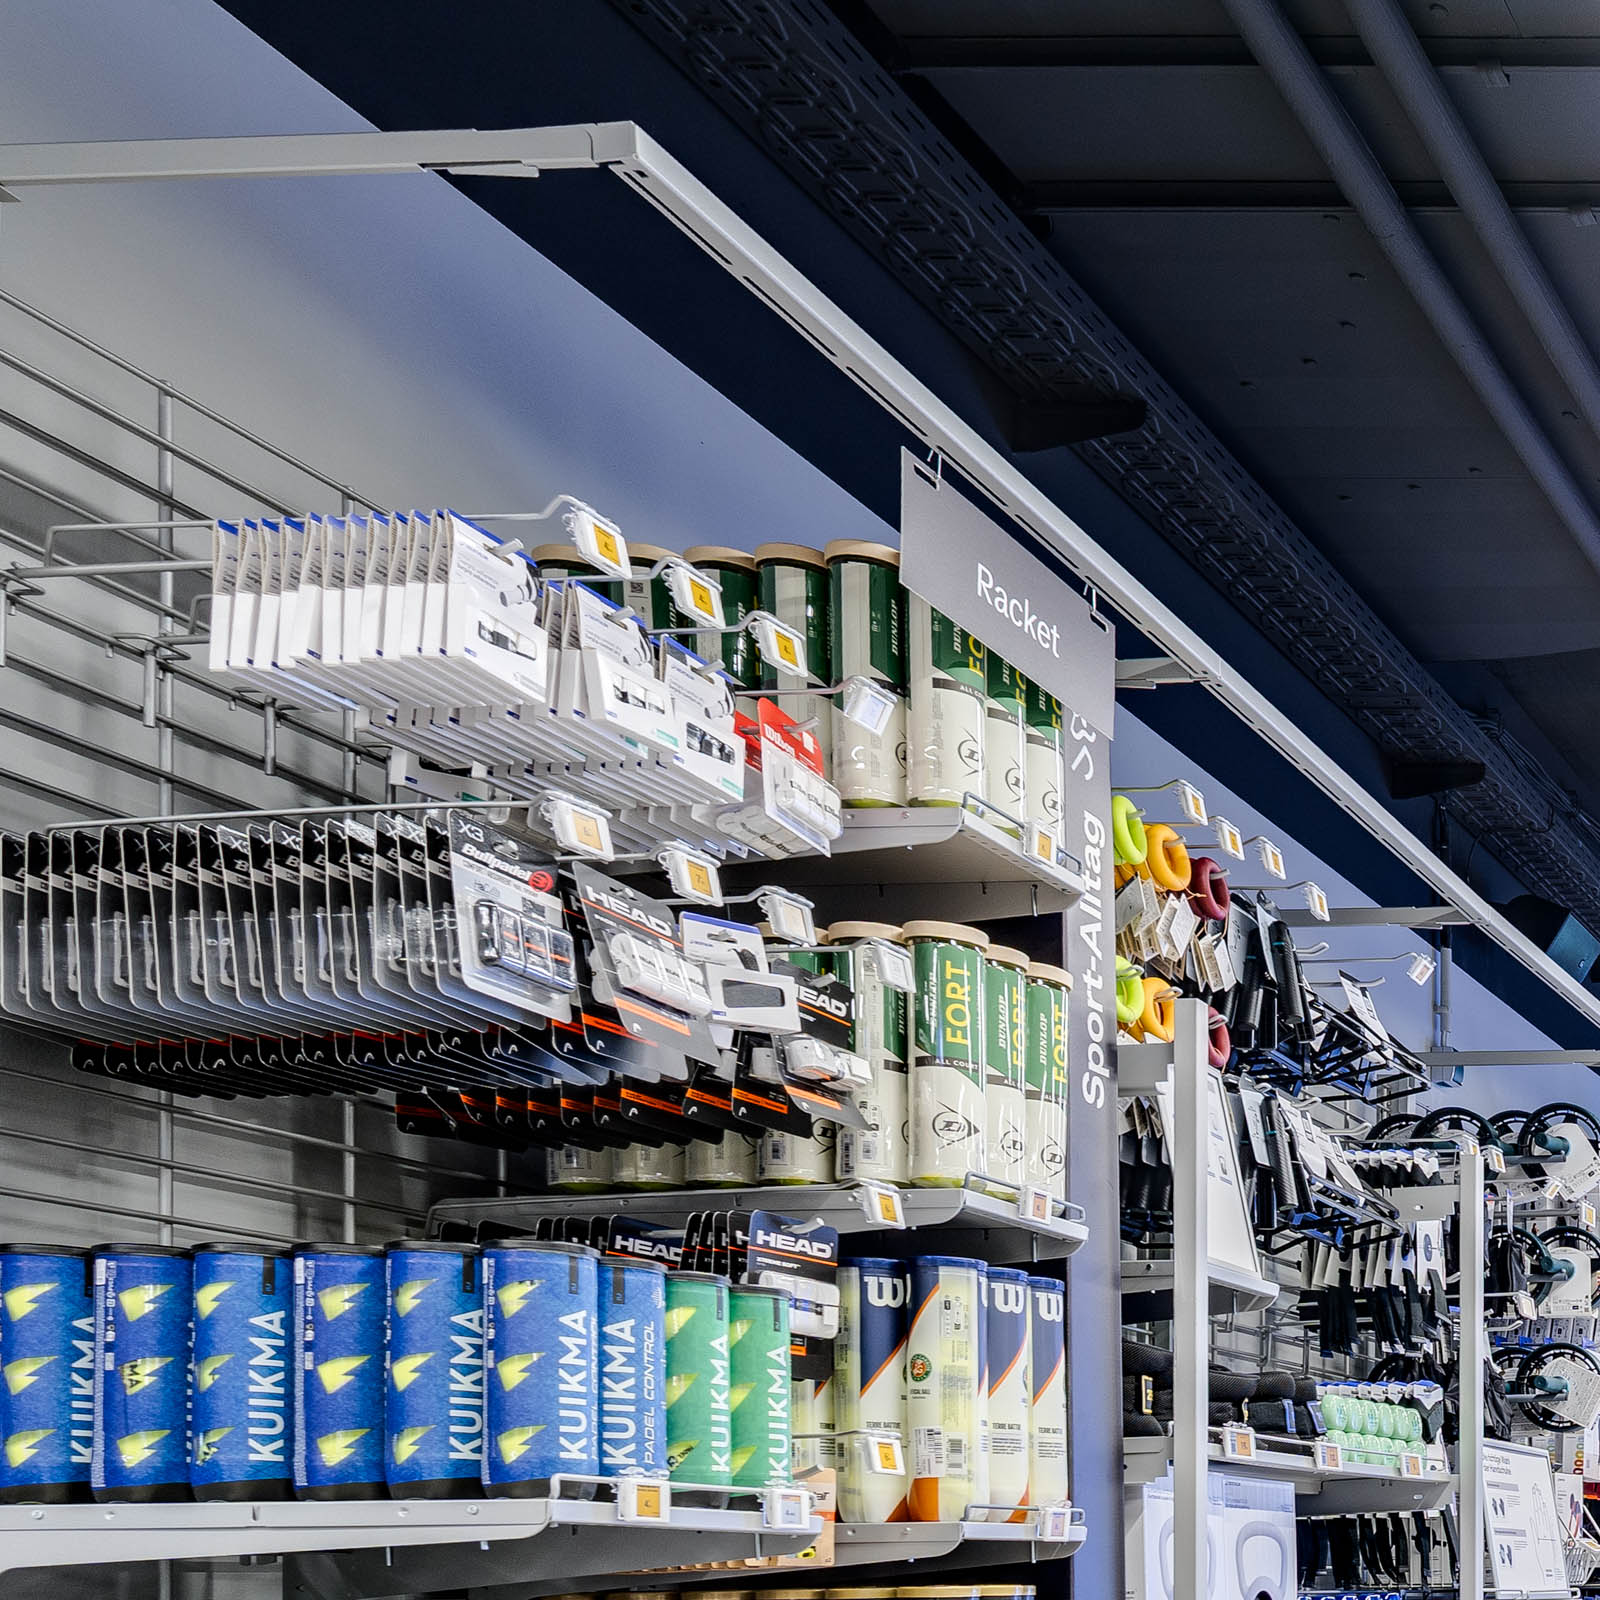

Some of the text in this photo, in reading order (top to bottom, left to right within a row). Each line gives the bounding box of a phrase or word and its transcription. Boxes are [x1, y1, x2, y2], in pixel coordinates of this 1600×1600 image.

[977, 562, 1060, 658] Racket
[458, 819, 485, 843] X3
[462, 842, 532, 882] Bullpadel
[585, 886, 672, 937] HEAD
[1081, 809, 1106, 1109] Sport-Alltag
[797, 989, 849, 1017] EAD
[946, 960, 971, 1045] FORT
[998, 995, 1008, 1049] DUNLOP
[1012, 987, 1026, 1067] FORT
[1040, 1013, 1048, 1066] DUNLOP
[935, 1058, 951, 1067] ALL
[1054, 1005, 1069, 1084] FORT
[614, 1235, 681, 1260] HEAD
[756, 1229, 832, 1259] HEAD
[248, 1310, 286, 1462] KUIKMA
[449, 1309, 485, 1460] KUIKMA
[558, 1310, 588, 1460] KUIKMA
[602, 1318, 638, 1466] KUIKMA
[643, 1320, 656, 1464] PADEL CONTROL
[709, 1334, 730, 1472] KUIKMA
[768, 1344, 788, 1484] KUIKMA
